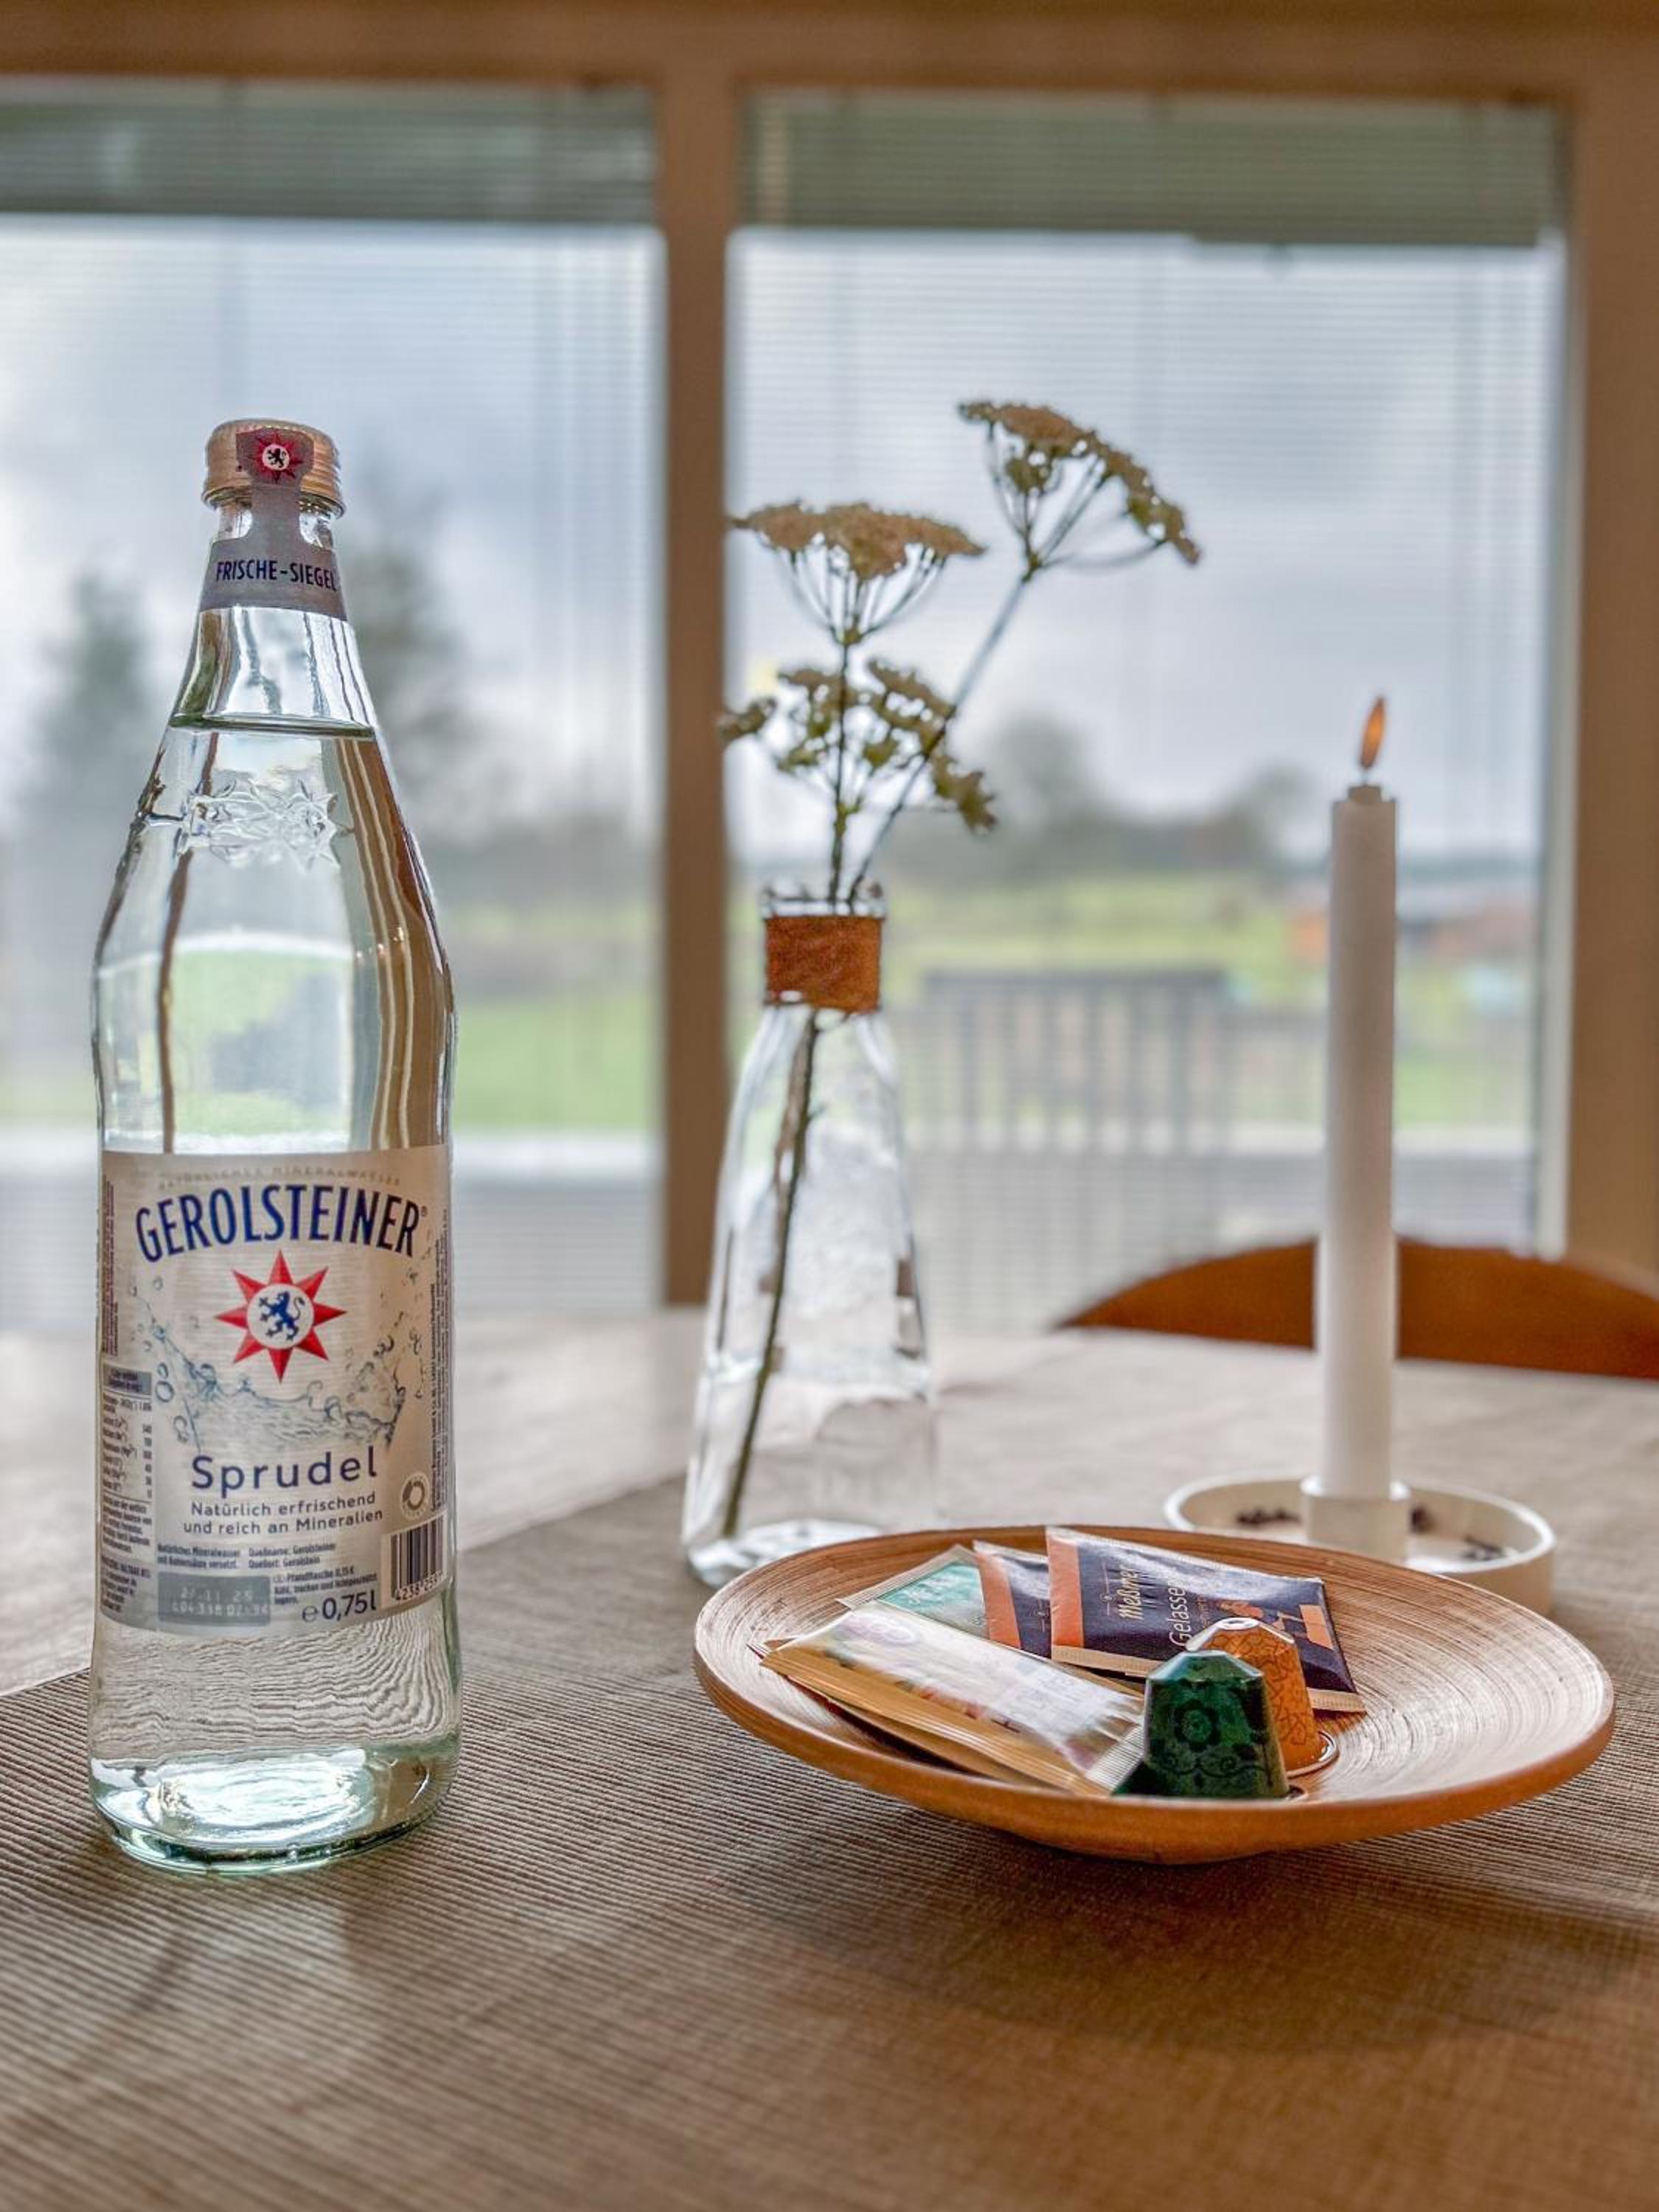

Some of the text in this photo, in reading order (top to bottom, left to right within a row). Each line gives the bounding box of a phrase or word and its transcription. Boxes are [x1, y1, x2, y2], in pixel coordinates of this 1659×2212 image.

[216, 560, 338, 591] FRISCHE-SIEGEL
[192, 1445, 378, 1499] Sprudel
[191, 1492, 375, 1517] Natürlich erfrischend
[183, 1509, 383, 1534] und reich an Mineralien
